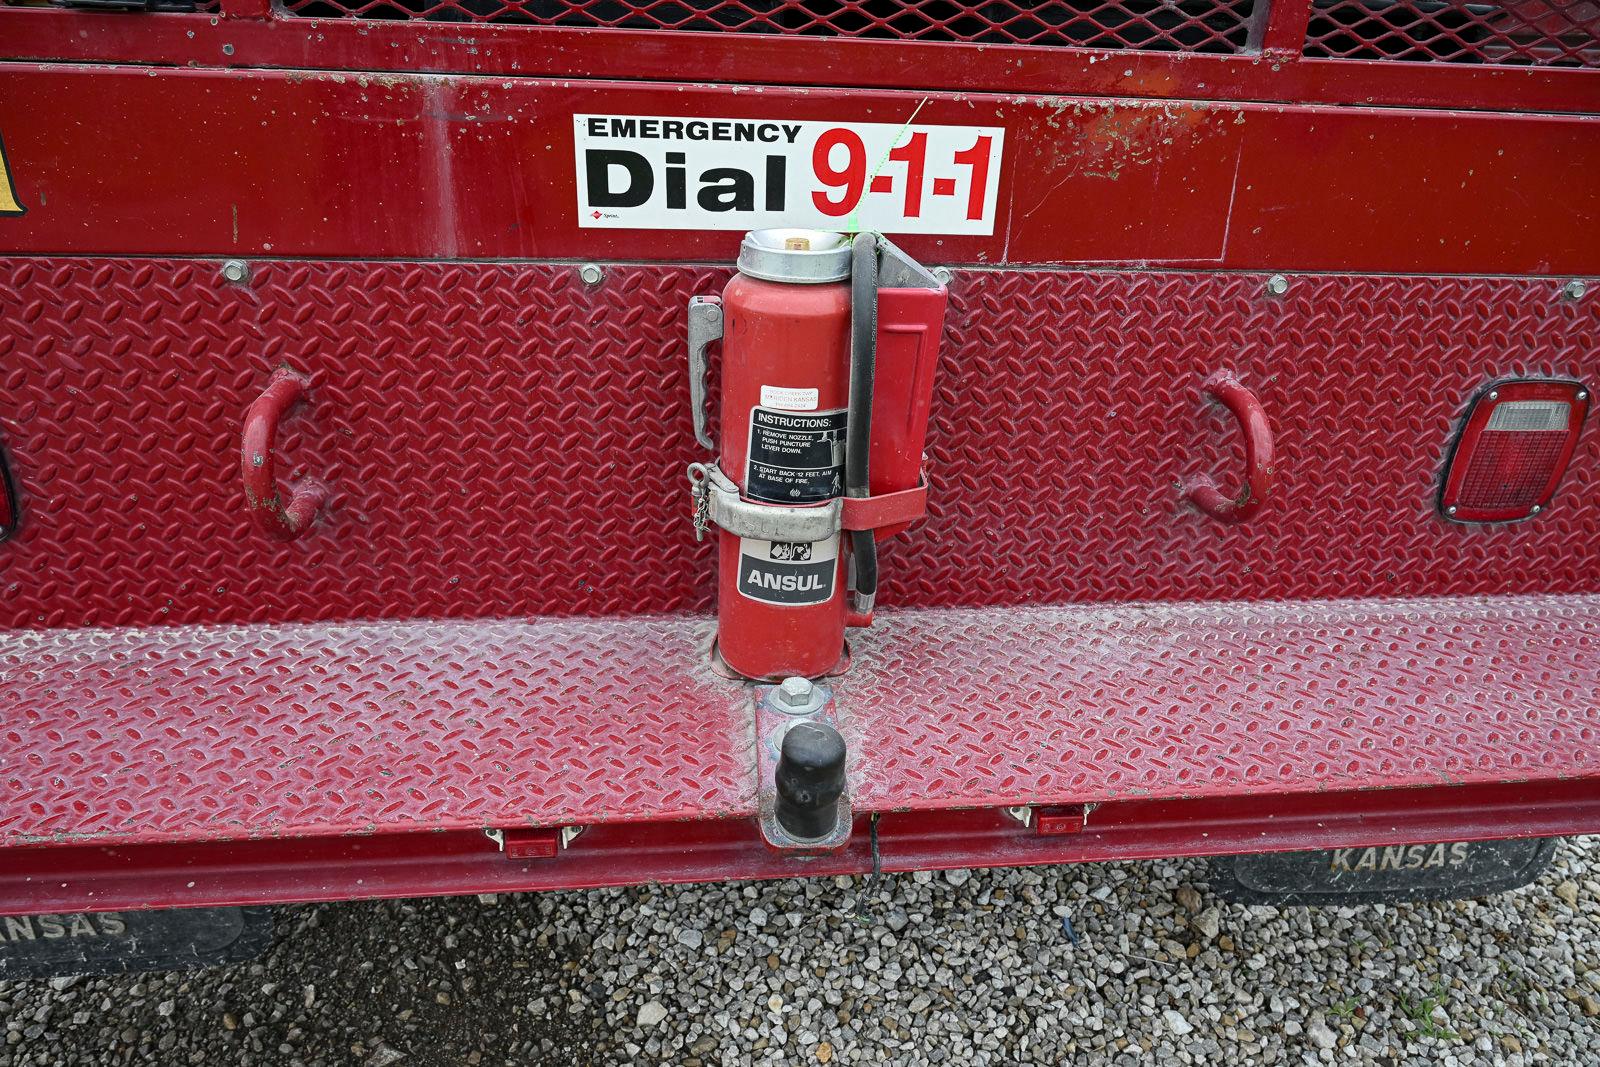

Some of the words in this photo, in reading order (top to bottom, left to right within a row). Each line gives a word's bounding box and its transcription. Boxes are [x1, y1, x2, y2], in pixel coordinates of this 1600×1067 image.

[587, 118, 802, 144] EMERGENCY
[585, 149, 787, 213] Dial
[811, 127, 993, 221] 9-1-1
[758, 413, 832, 428] INSTRUCTIONS:
[762, 430, 787, 440] REMOVE
[762, 437, 778, 445] PUSH
[779, 440, 811, 448] PUNCTURE
[761, 444, 780, 452] LEVER
[759, 467, 777, 475] START
[767, 475, 783, 483] BASE
[747, 569, 823, 592] ANSUL
[1330, 841, 1469, 872] KANSAS
[0, 911, 126, 942] NSAS
